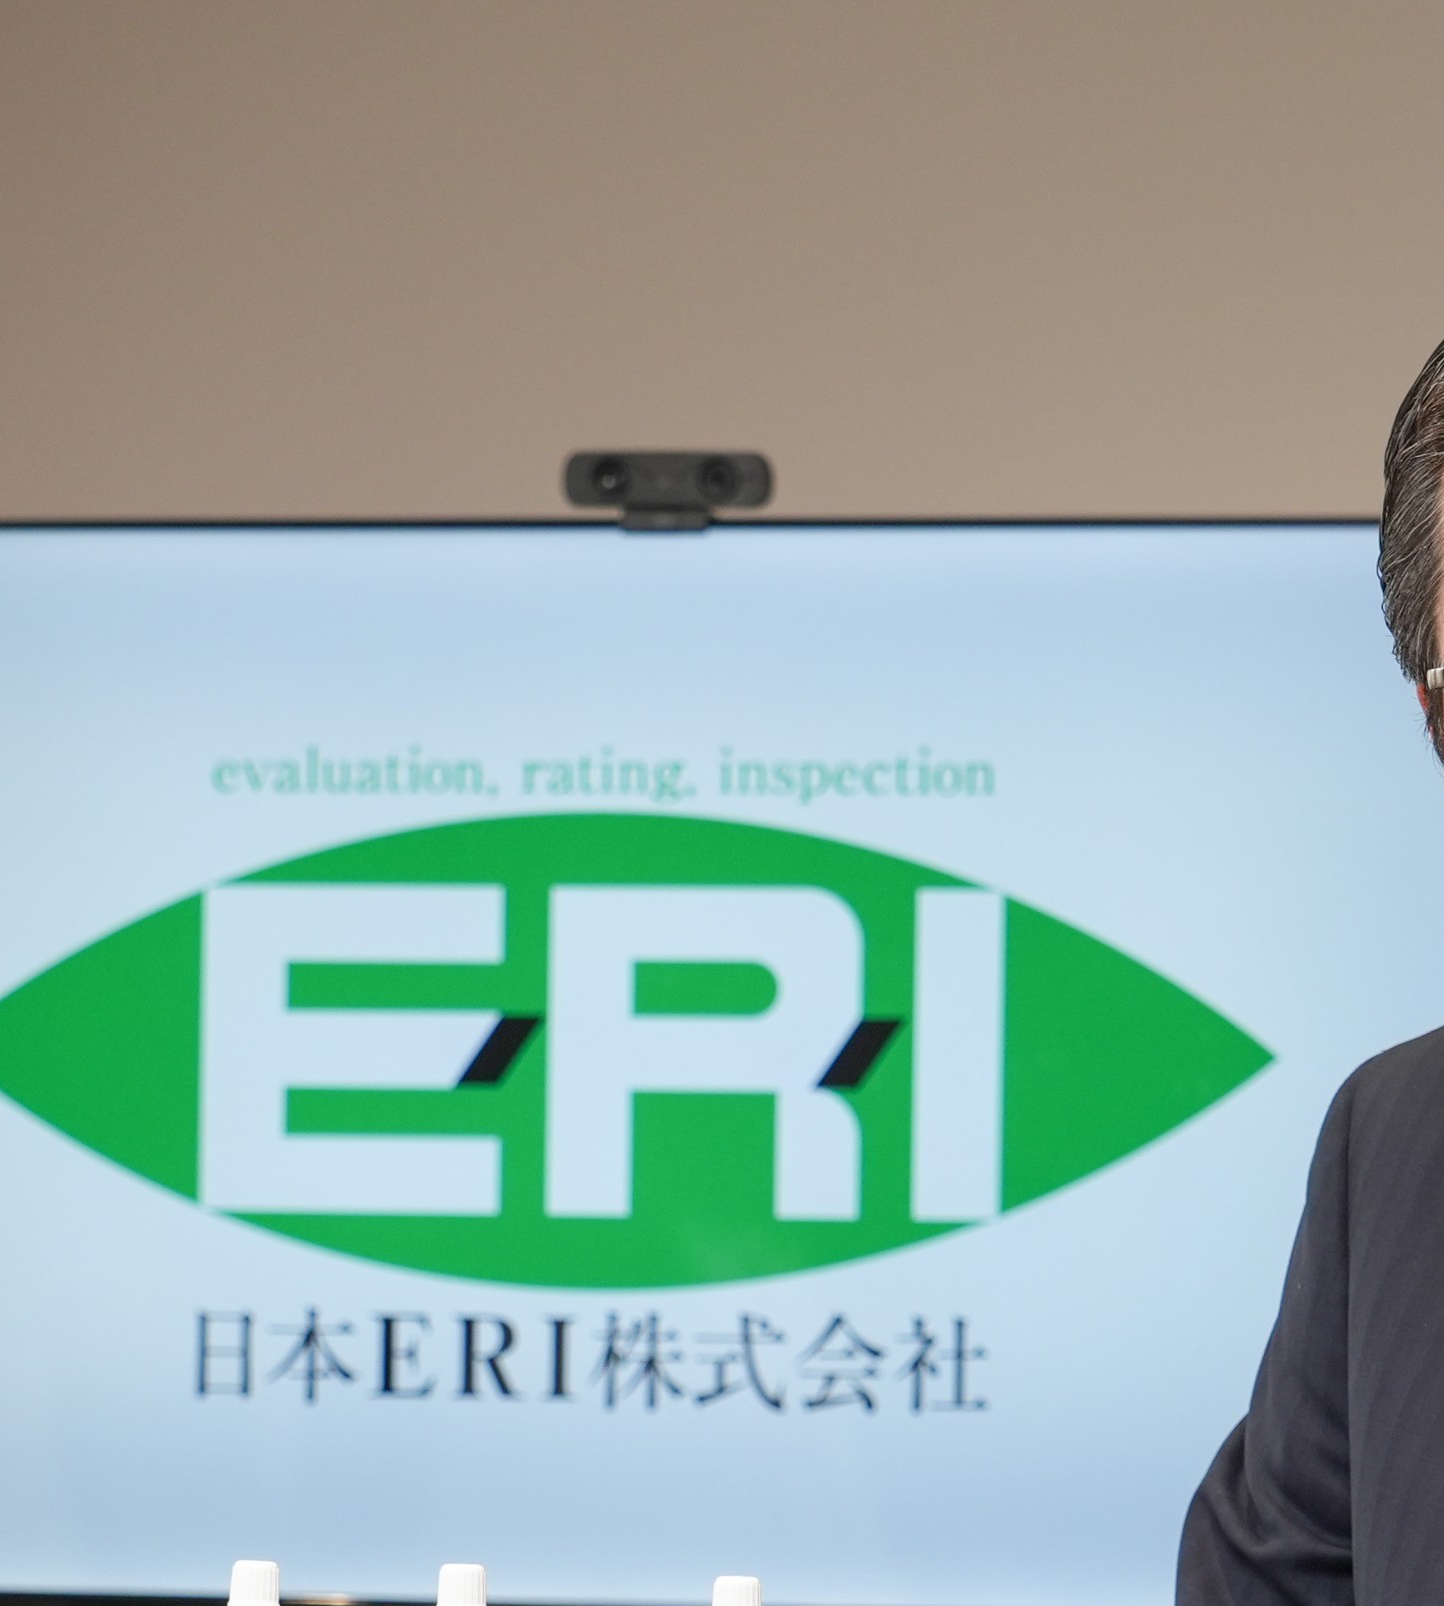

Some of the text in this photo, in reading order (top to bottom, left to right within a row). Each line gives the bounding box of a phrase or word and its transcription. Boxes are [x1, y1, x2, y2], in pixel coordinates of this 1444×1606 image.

[211, 747, 997, 804] evaluation, rating, inspection
[198, 883, 1006, 1222] ERI
[193, 1306, 991, 1416] 日本ERI株式会社
